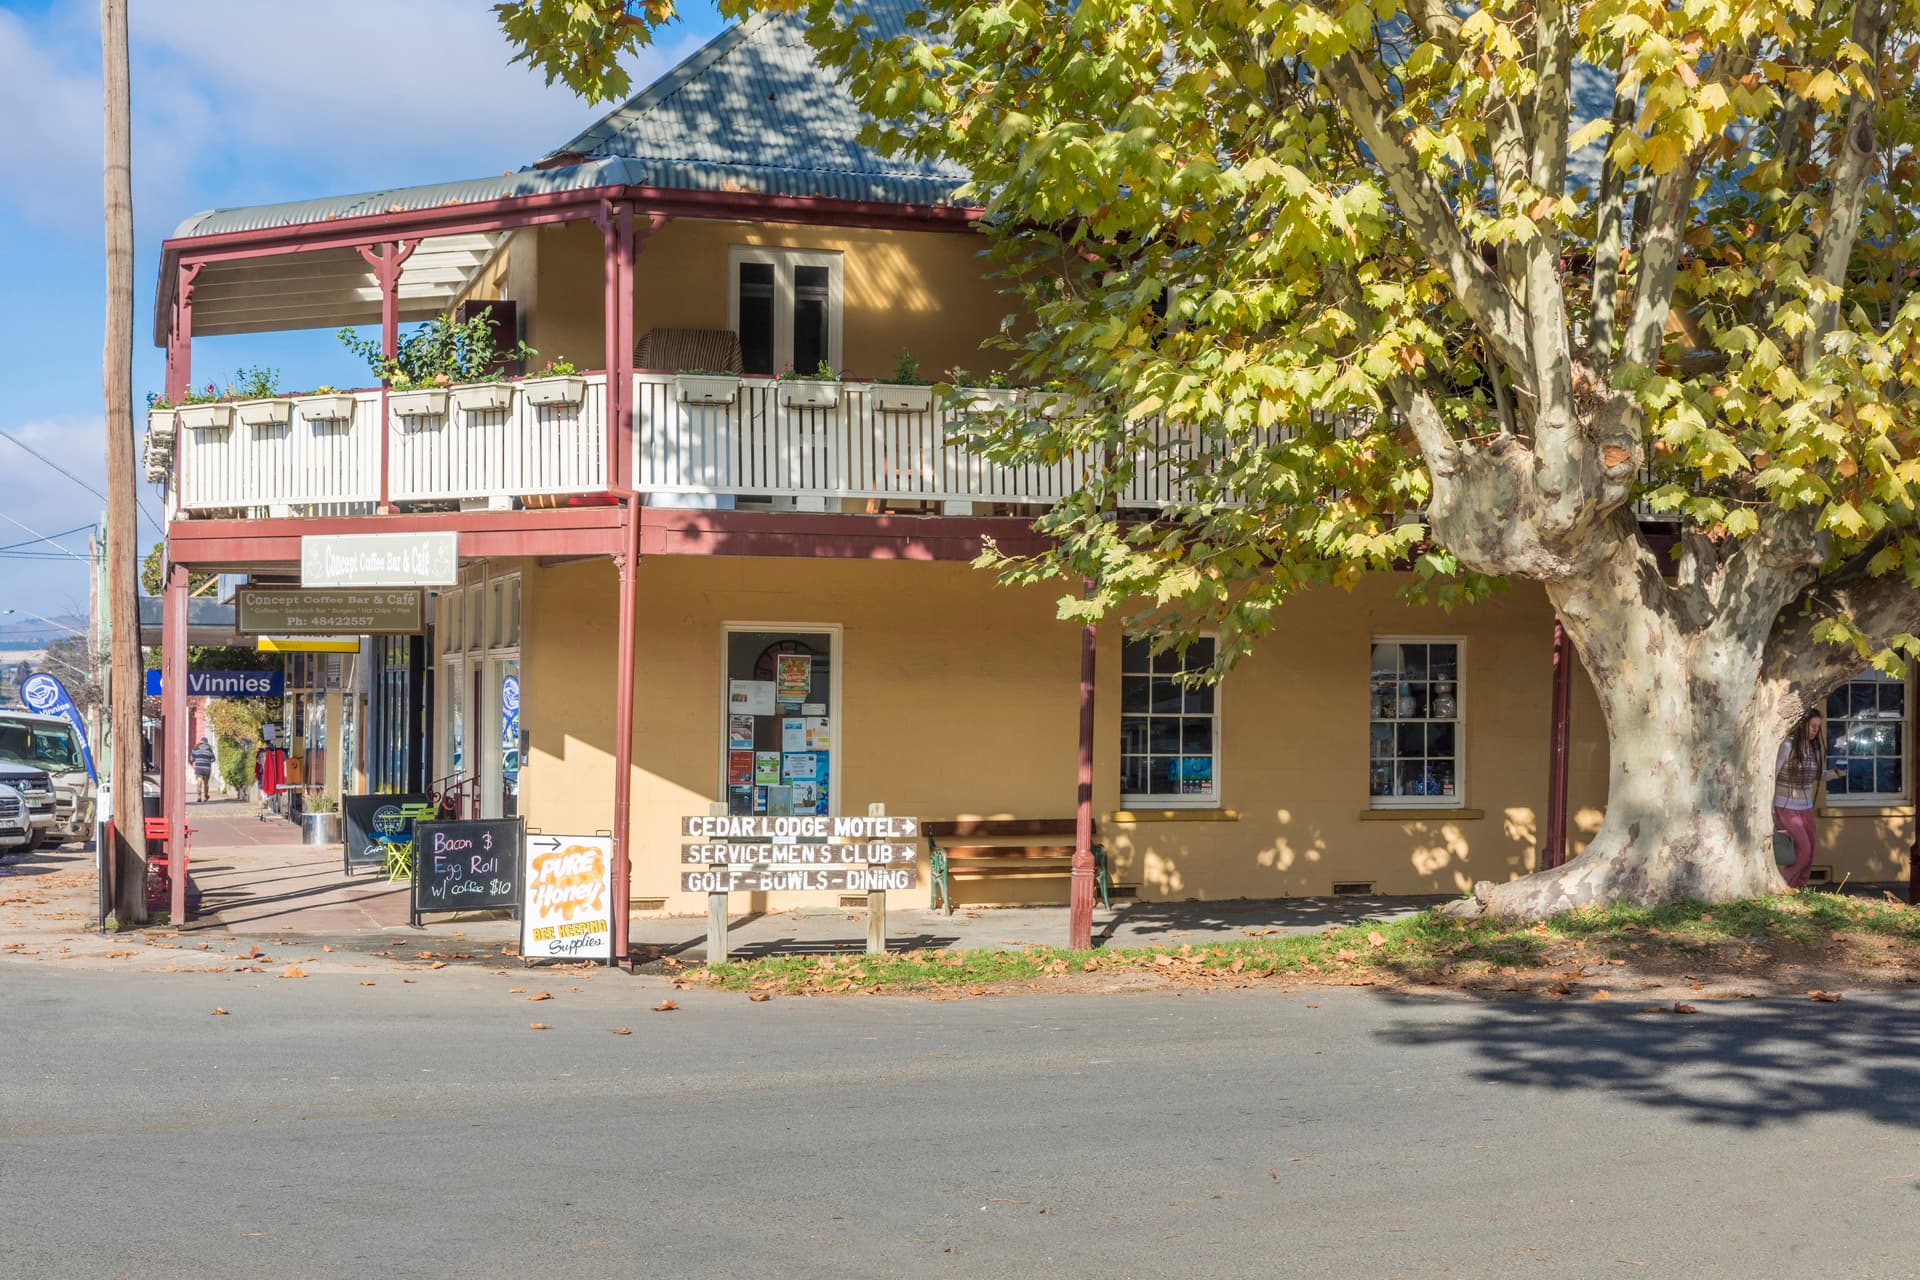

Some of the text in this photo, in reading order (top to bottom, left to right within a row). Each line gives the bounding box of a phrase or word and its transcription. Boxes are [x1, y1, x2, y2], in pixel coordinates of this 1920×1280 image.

[325, 543, 359, 579] Concept
[359, 551, 385, 572] Coffee
[387, 551, 401, 572] Bar
[402, 548, 411, 573] &
[246, 591, 415, 607] Concept Coffee Bar & Café
[287, 616, 375, 627] Ph: 48422557
[189, 674, 271, 692] Vinnies
[688, 817, 901, 838] CEDAR LODGE MOTEL
[434, 832, 473, 854] Bacon
[841, 843, 893, 864] CLUB
[434, 855, 498, 881] Egg Roll
[539, 850, 597, 881] PURE
[431, 878, 512, 900] w/ coffee $10
[532, 919, 609, 942] BEE KEEPING
[548, 931, 605, 956] Supplies
